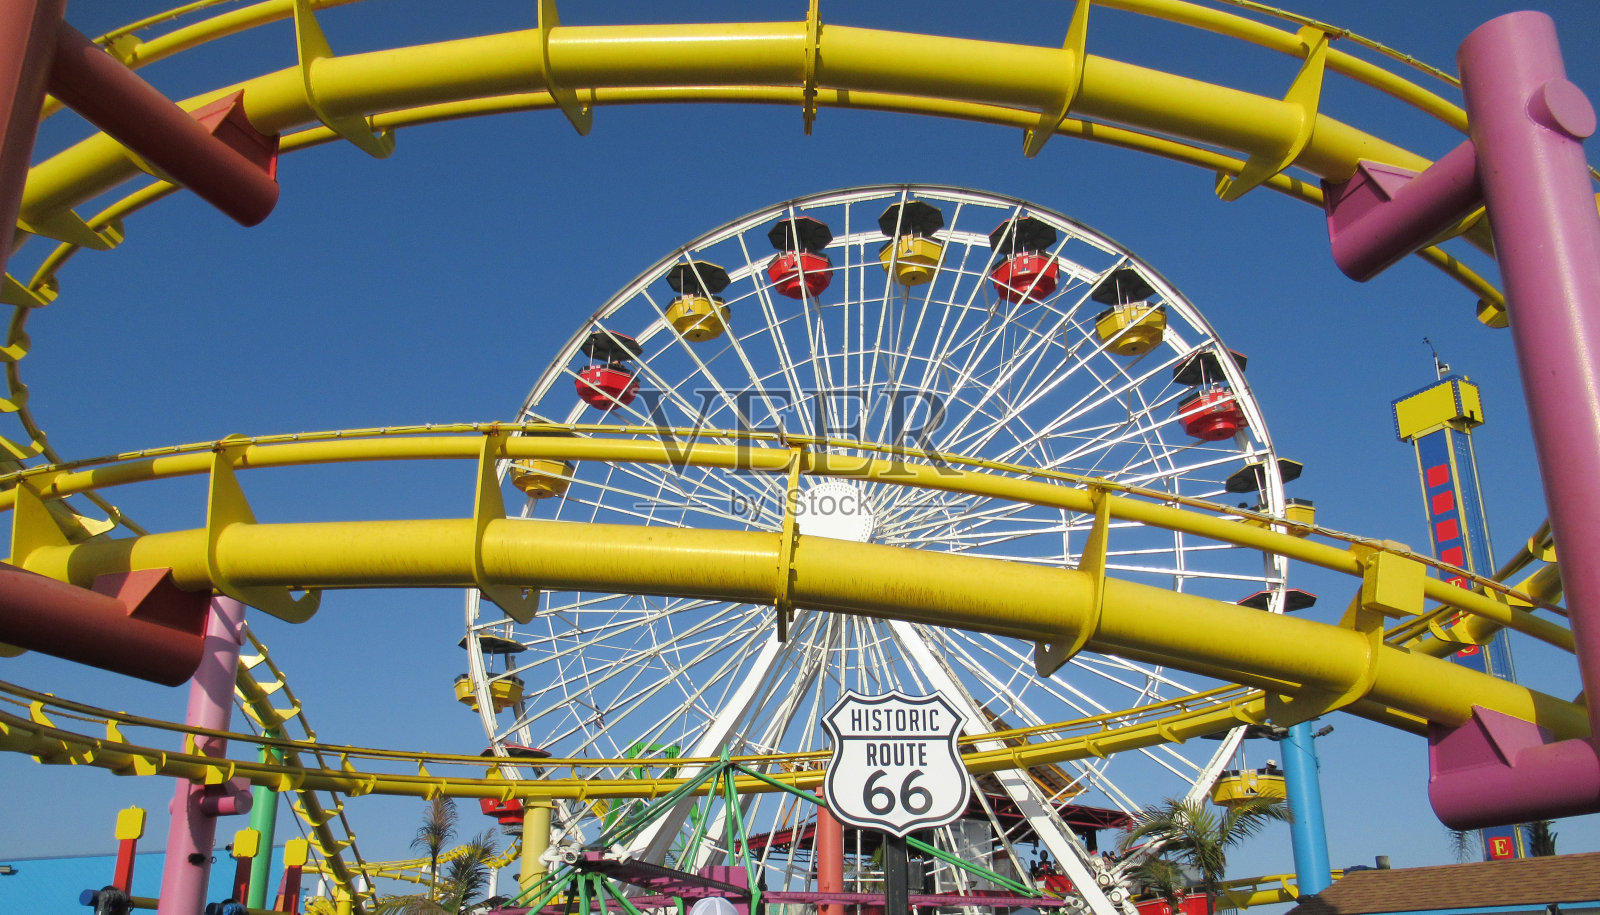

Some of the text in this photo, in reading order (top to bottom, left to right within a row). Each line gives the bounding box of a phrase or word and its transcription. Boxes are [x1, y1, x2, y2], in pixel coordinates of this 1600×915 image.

[851, 708, 940, 732] HISTORIC
[866, 742, 928, 767] ROUTE
[863, 769, 933, 816] 66
[1492, 838, 1509, 857] E
